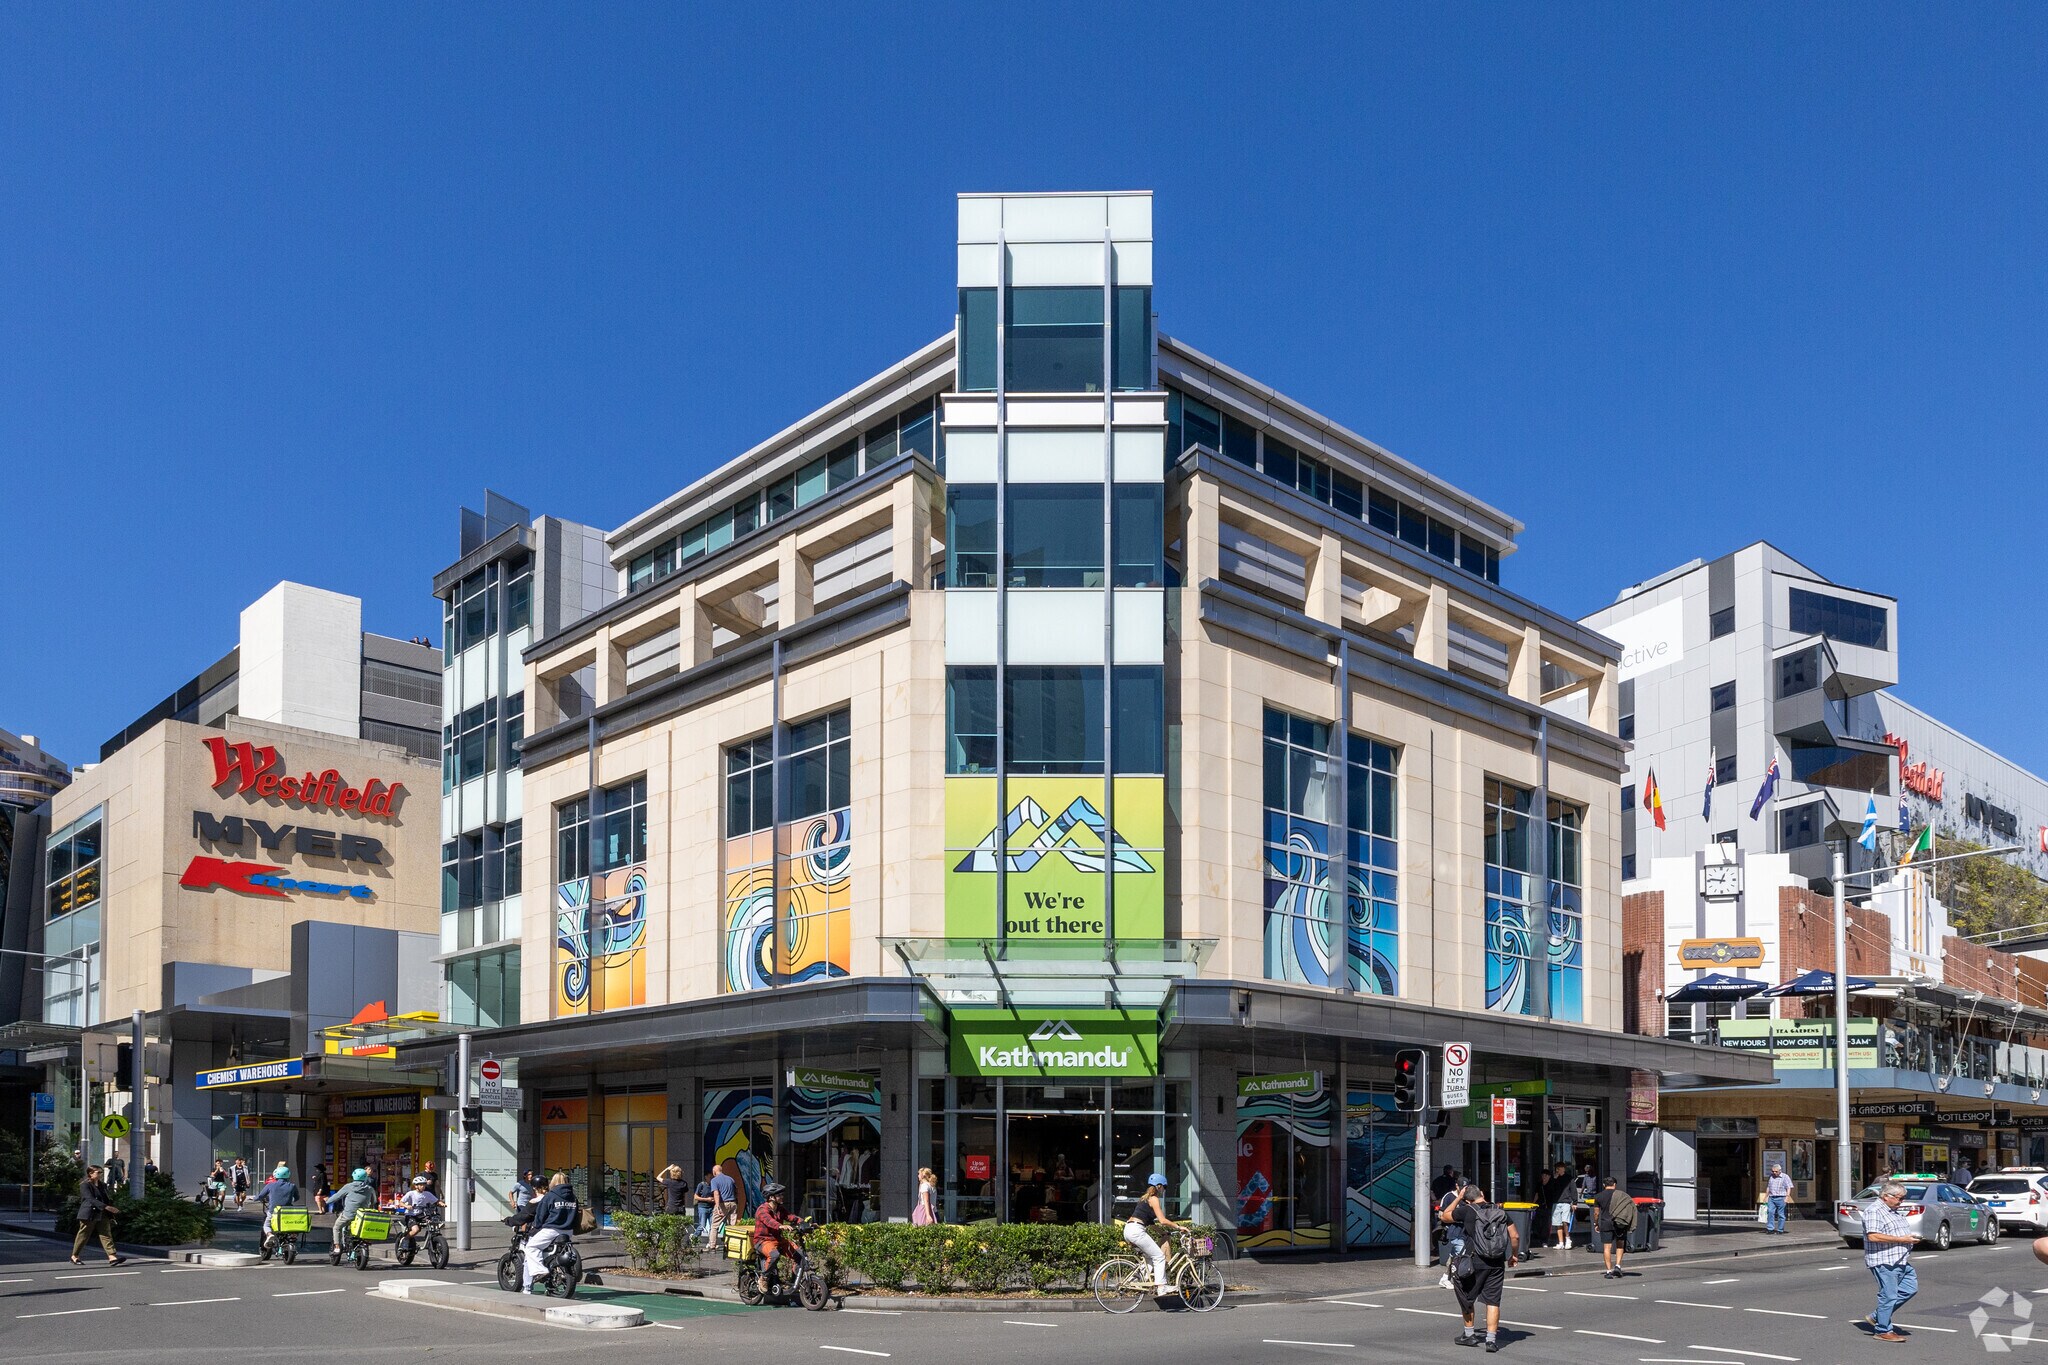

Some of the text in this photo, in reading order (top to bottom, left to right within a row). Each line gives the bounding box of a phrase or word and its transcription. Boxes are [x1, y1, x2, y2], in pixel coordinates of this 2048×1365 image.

[202, 737, 403, 818] Westfield
[1965, 792, 2018, 838] MYER
[193, 811, 383, 866] MYER
[1023, 891, 1085, 910] We're
[1004, 915, 1104, 934] out there
[1741, 1039, 1767, 1047] HOURS
[1797, 1038, 1819, 1046] OPEN
[207, 1063, 288, 1085] CHEMIST WAREHOUSE
[1449, 1068, 1463, 1076] NO
[821, 1074, 869, 1089] Kathmandu
[1261, 1077, 1309, 1090] Kathmandu
[344, 1099, 372, 1113] CHEMIST
[1858, 1105, 1895, 1114] GARDENS
[1899, 1103, 1927, 1113] HOTEL
[1476, 1110, 1488, 1120] TAB
[1938, 1112, 1991, 1122] BOTTLESHOP
[2021, 1118, 2044, 1126] OPEN
